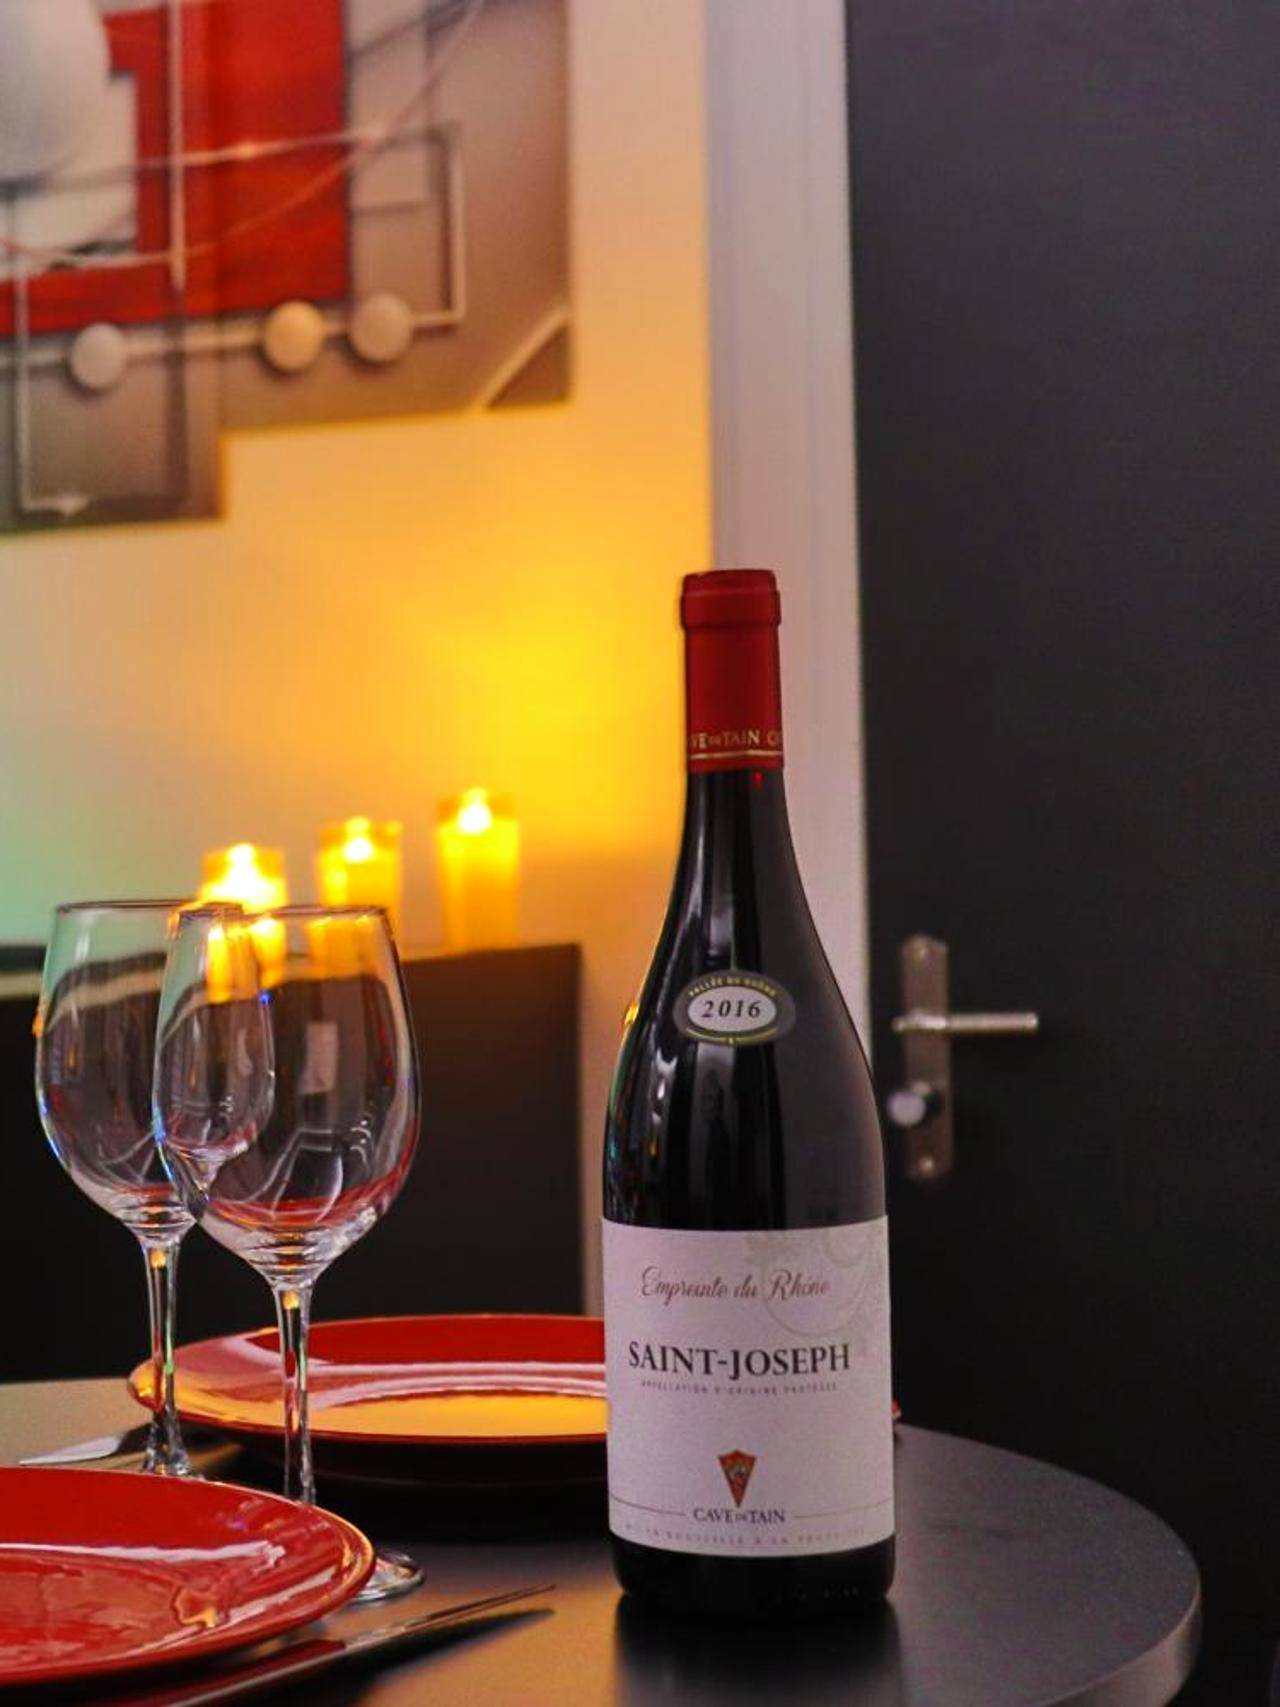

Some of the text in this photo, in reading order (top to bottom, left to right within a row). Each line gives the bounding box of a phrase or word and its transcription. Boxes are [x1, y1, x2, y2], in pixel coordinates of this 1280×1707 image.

[723, 729, 760, 747] TAIN
[701, 1000, 761, 1018] 2016
[733, 1273, 759, 1298] du
[628, 1341, 851, 1381] SAINT-JOSEPH
[693, 1508, 735, 1524] CAVE
[747, 1508, 786, 1525] TAIN
